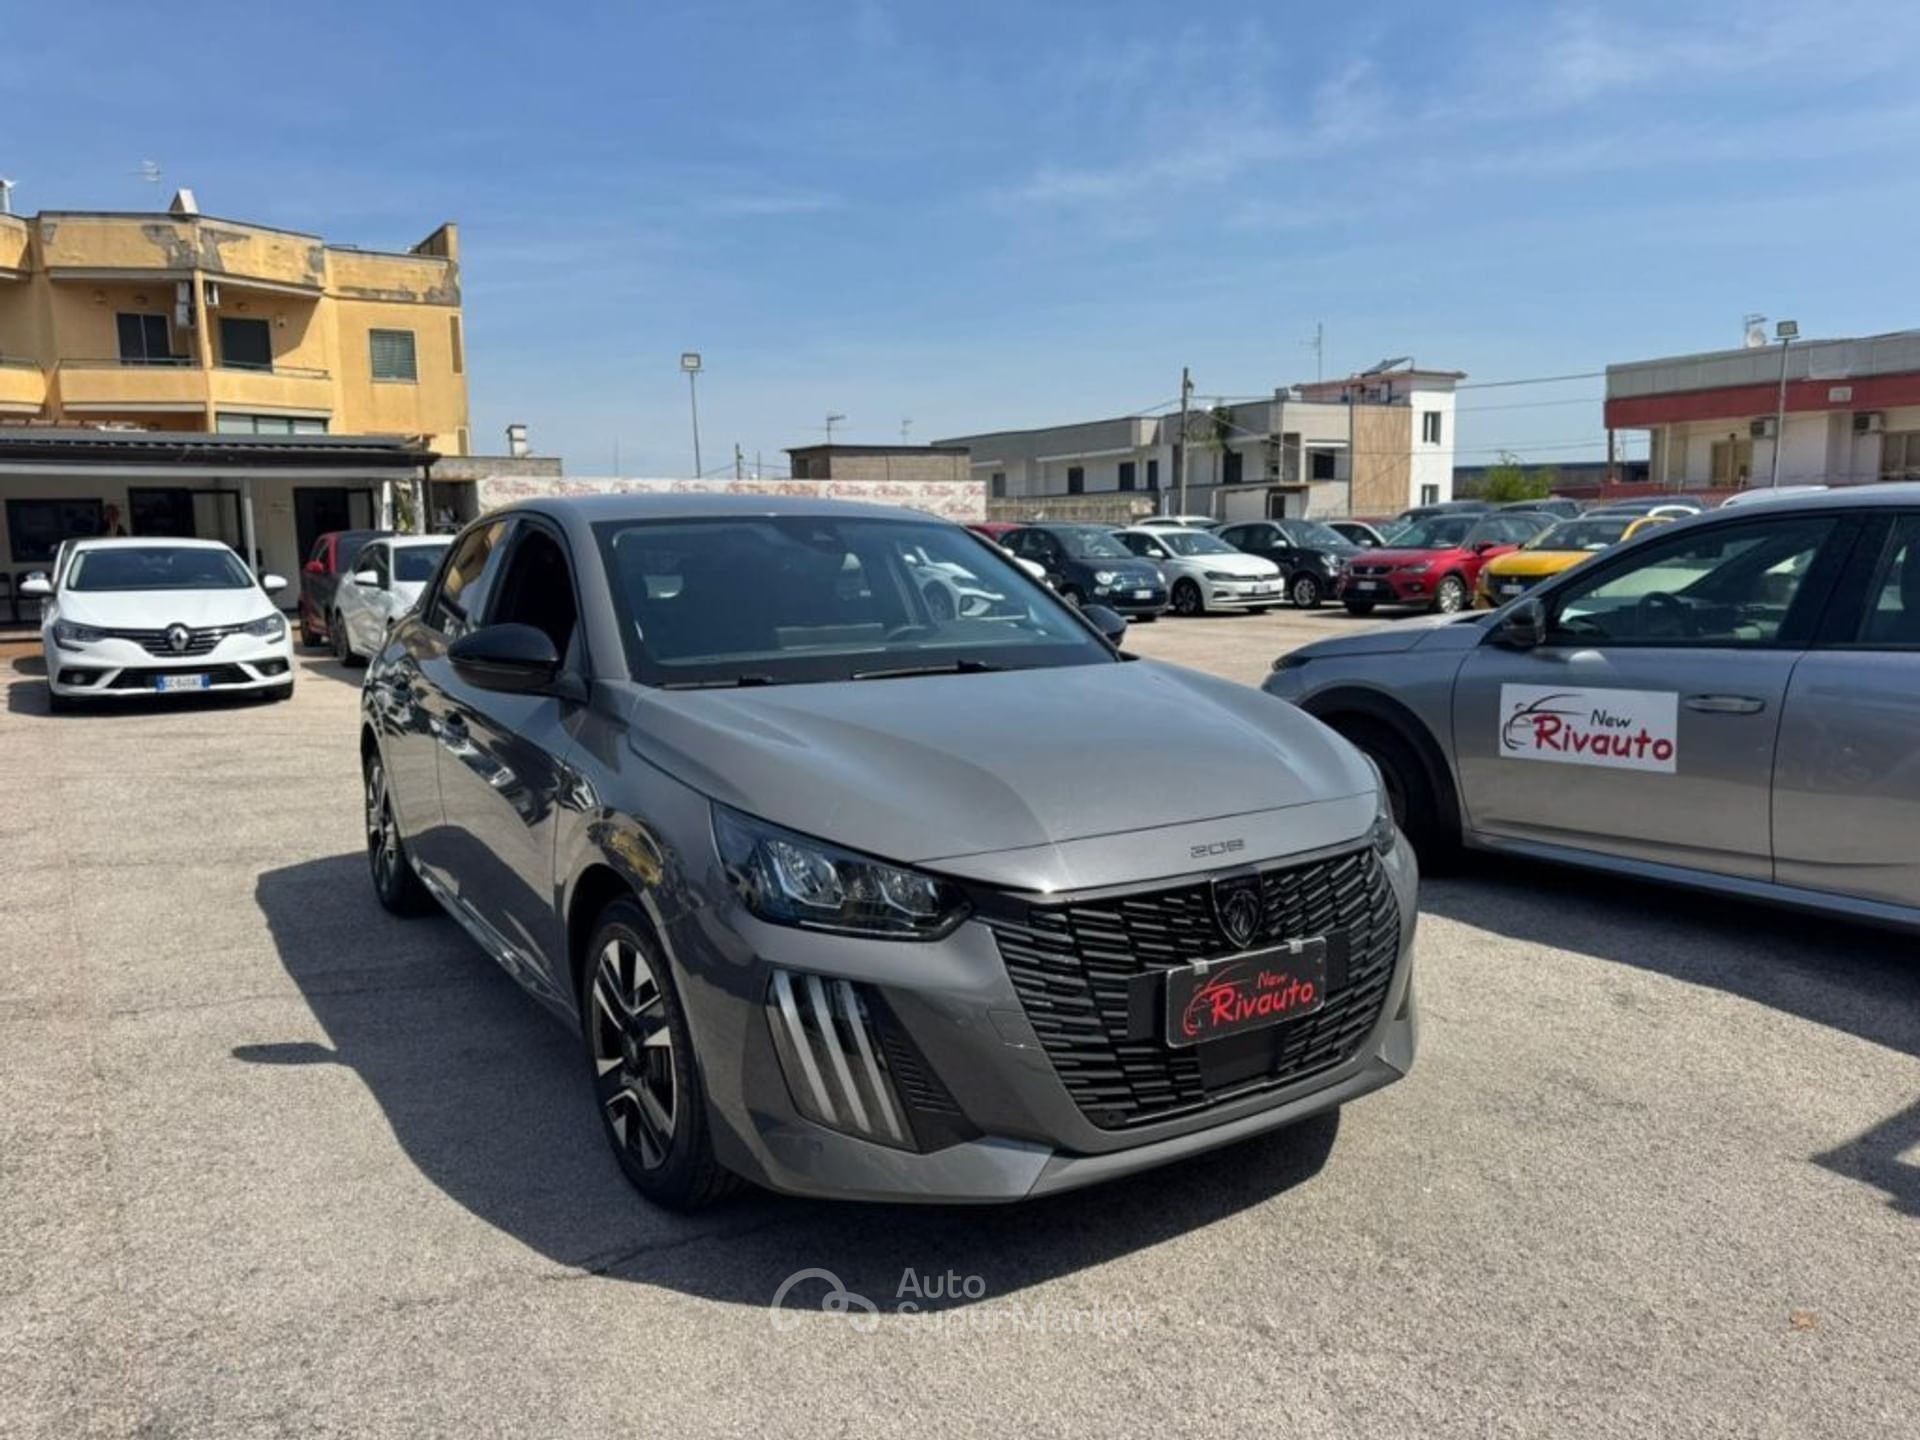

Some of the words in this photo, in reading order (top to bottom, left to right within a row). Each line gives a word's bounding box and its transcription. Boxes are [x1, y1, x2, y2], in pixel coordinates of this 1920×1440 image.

[1590, 709, 1632, 728] New
[1532, 714, 1673, 760] Rivauto
[1190, 838, 1244, 858] 208
[1257, 970, 1288, 989] New
[1211, 979, 1313, 1026] Rivauto
